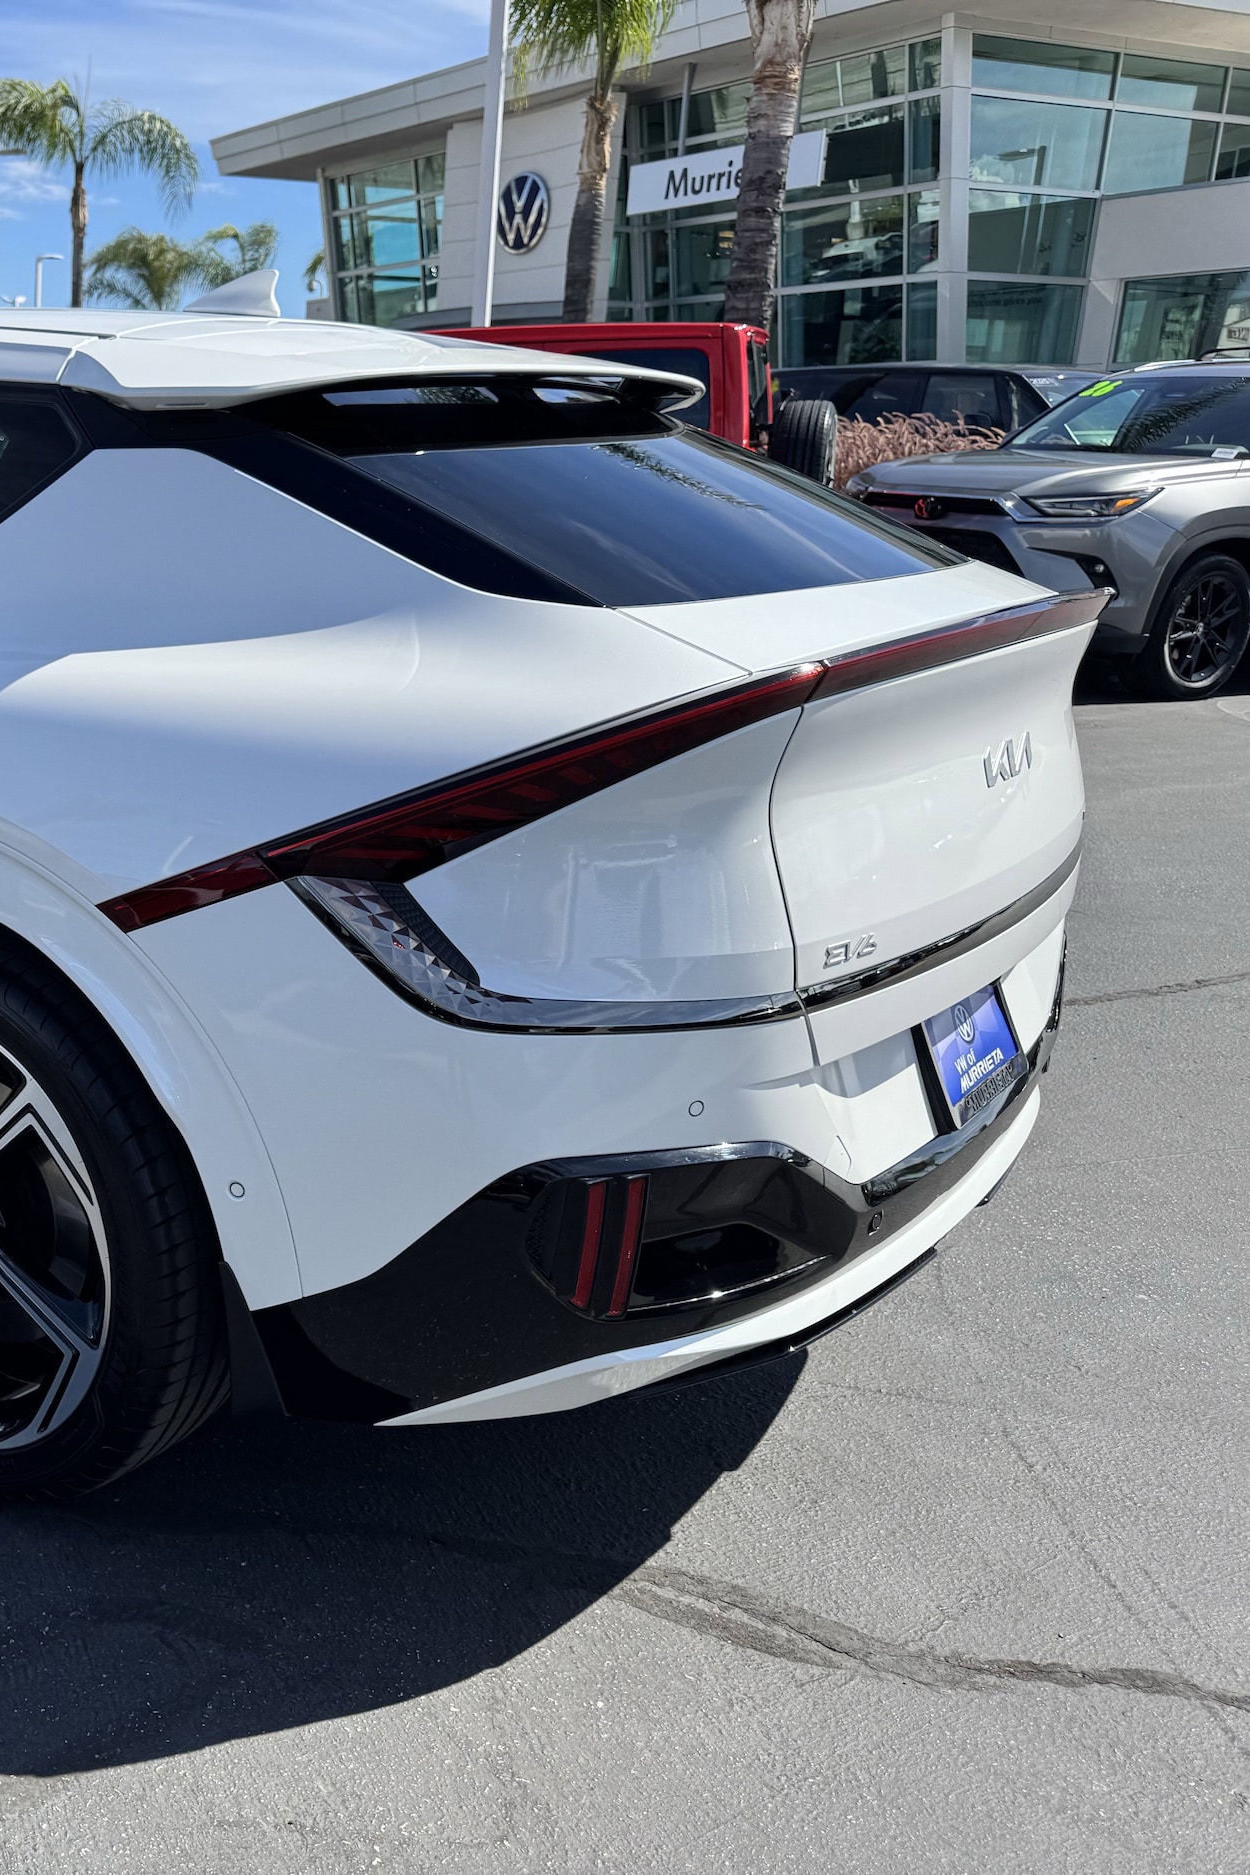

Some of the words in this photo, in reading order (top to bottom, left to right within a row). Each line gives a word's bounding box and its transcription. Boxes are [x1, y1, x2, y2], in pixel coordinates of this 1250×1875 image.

[823, 932, 877, 969] EV6
[954, 1054, 968, 1075] VW
[967, 1048, 976, 1066] of
[960, 1047, 1004, 1094] MURRIETA
